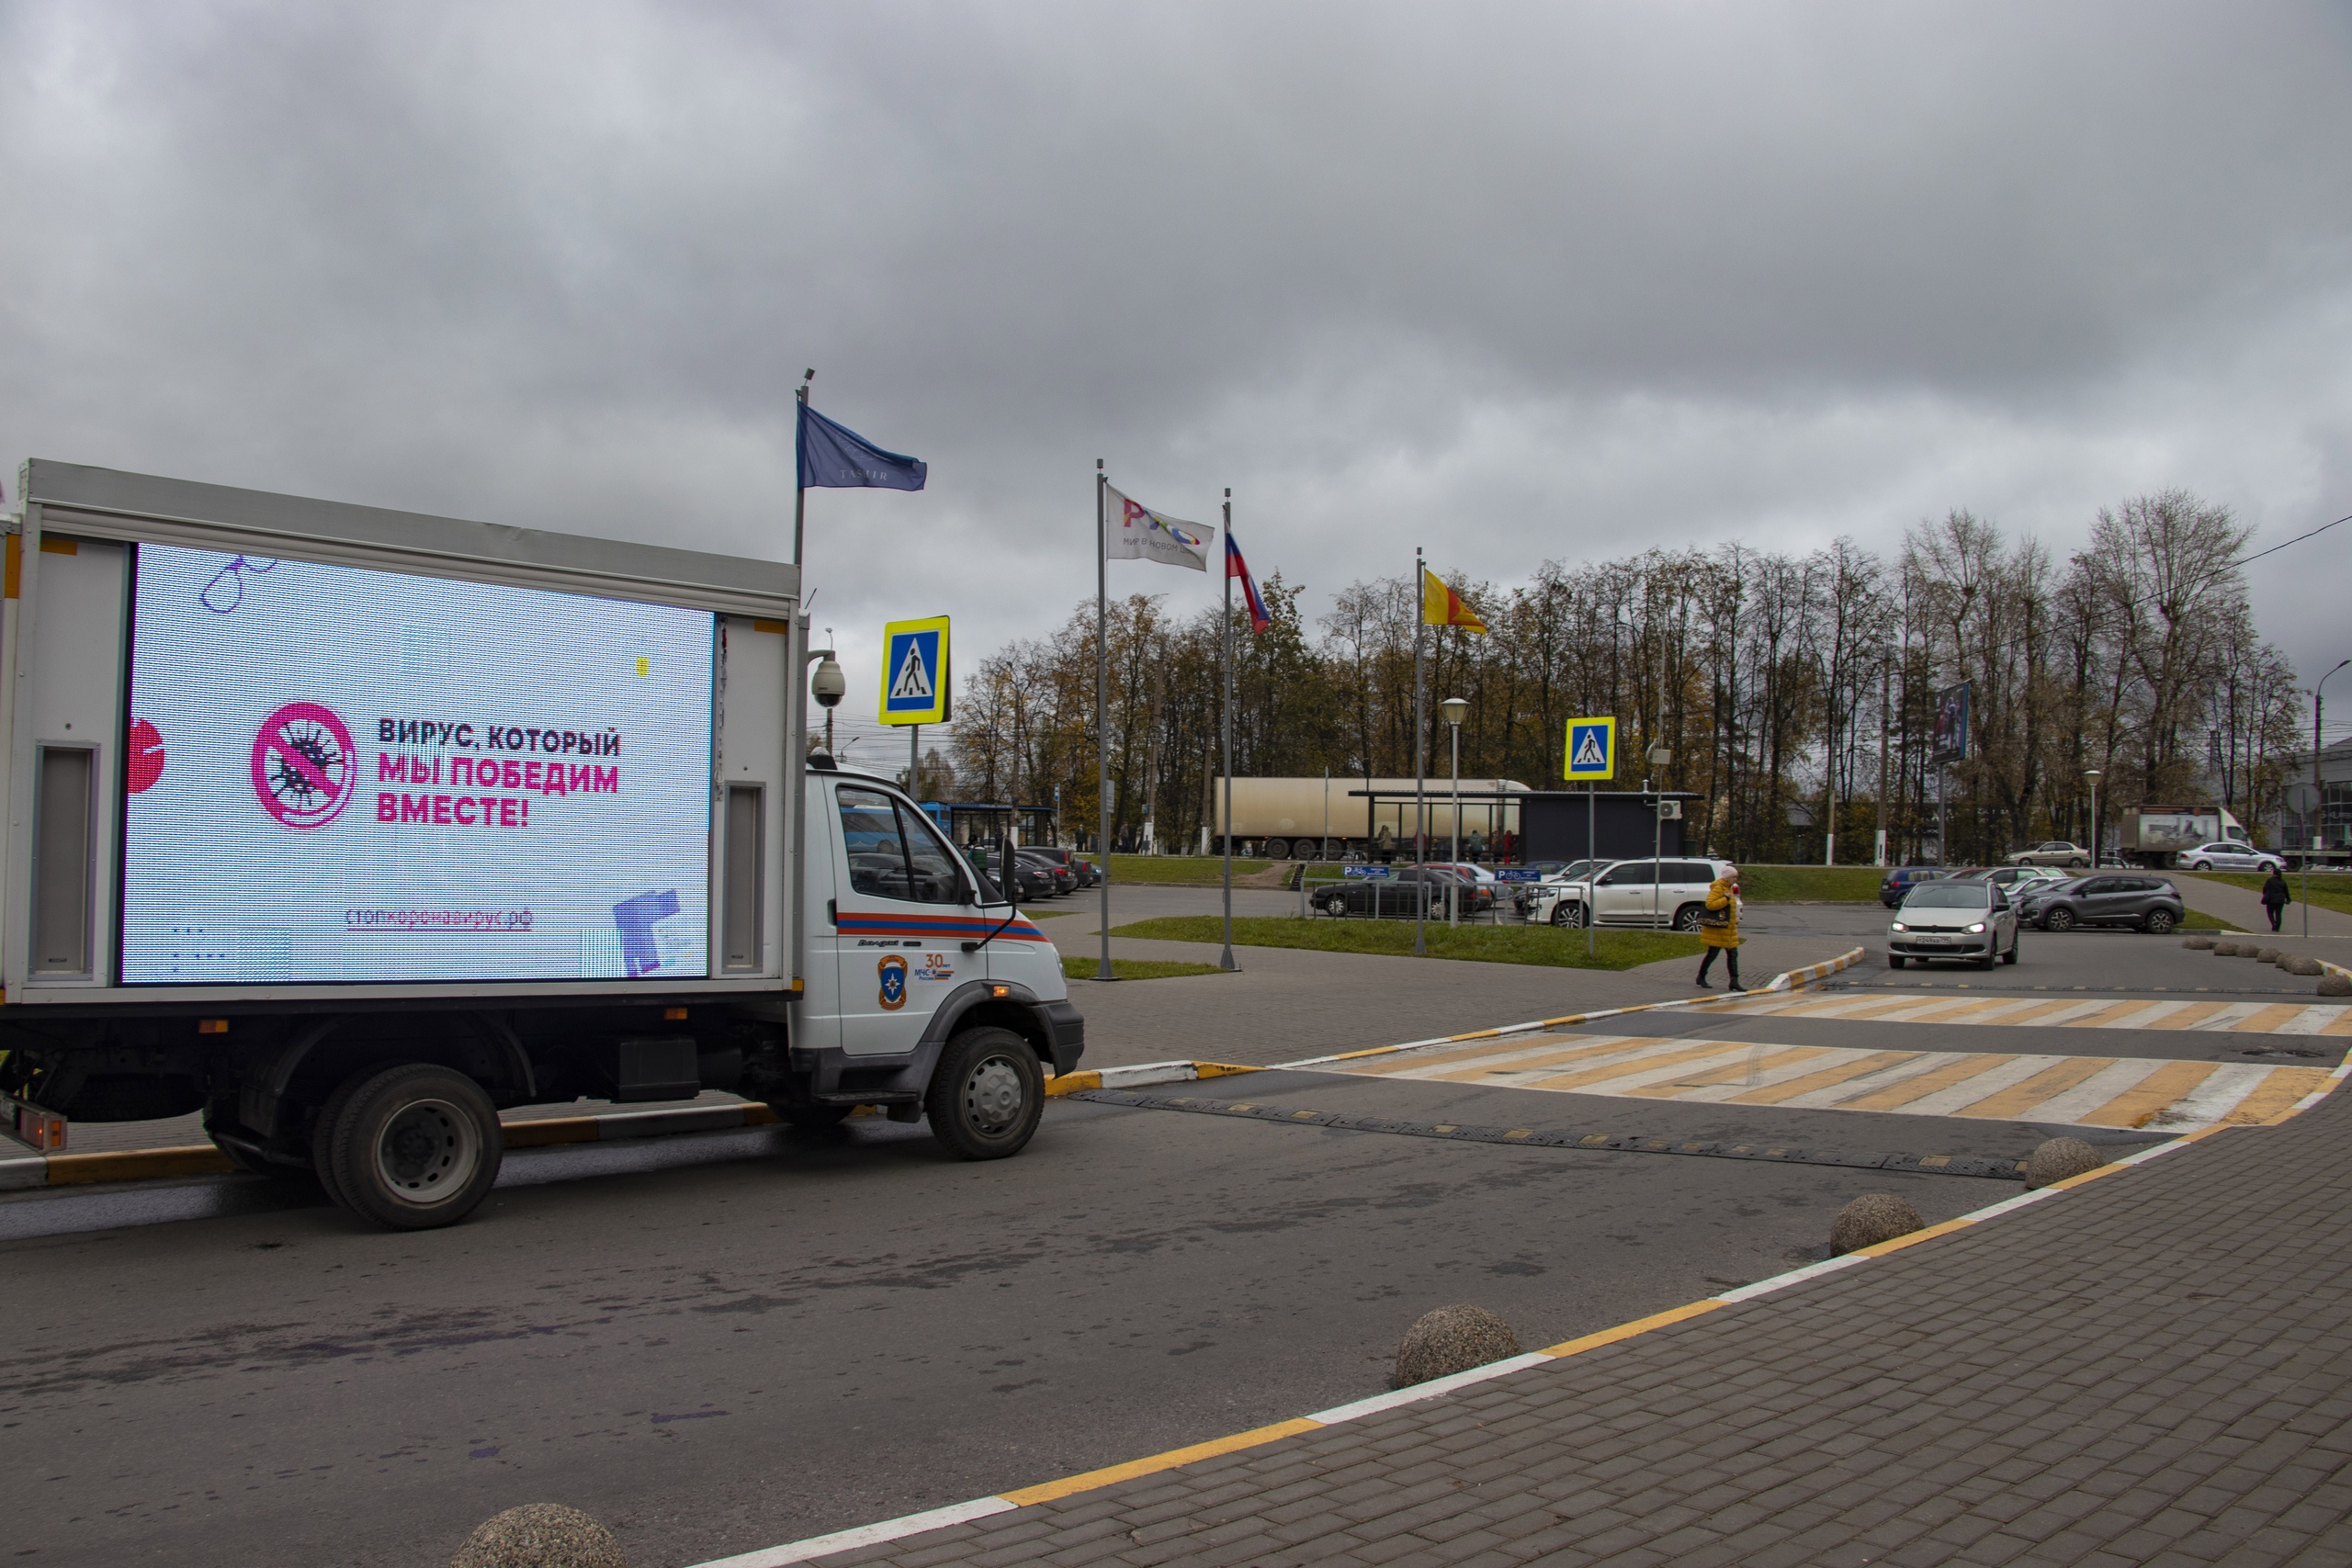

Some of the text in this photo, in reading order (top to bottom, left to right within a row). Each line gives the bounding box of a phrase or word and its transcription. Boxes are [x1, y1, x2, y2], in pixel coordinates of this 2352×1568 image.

[1123, 537, 1139, 546] МИР
[1141, 537, 1148, 546] В
[1149, 540, 1178, 552] НОВОМ
[379, 717, 620, 757] ВИРУС, КОТОРЫЙ
[379, 752, 618, 796] МЫ ПОБЕДИМ
[377, 792, 528, 827] ВМЕСТЕ!
[345, 907, 534, 931] стопкоронавирус.рф
[914, 968, 930, 976] МЧС
[925, 953, 944, 968] 30
